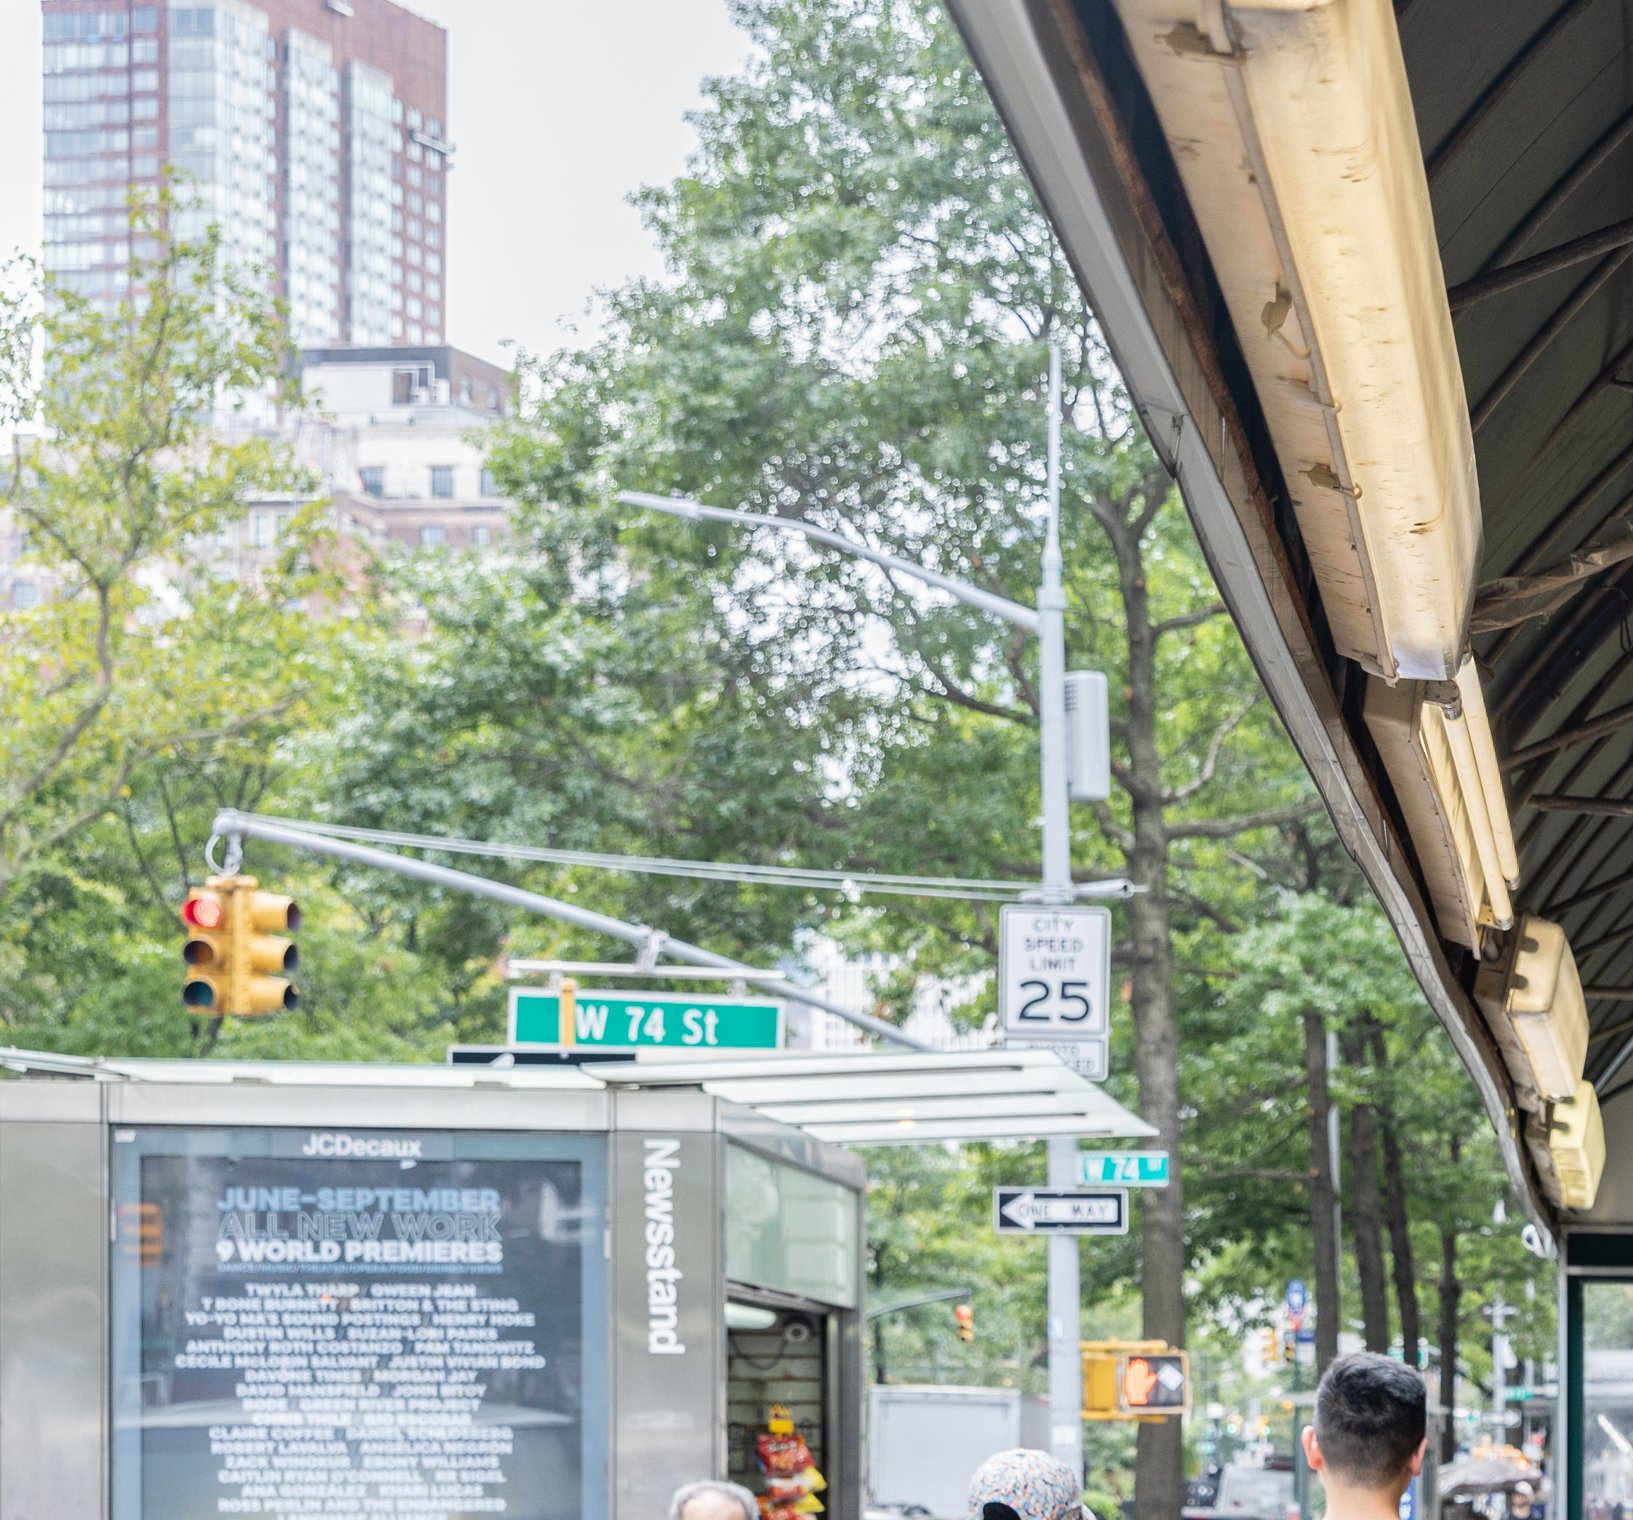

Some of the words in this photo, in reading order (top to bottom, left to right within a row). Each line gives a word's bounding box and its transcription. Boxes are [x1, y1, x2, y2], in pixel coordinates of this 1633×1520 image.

[1032, 917, 1075, 932] CITY
[1024, 937, 1084, 953] SPEED
[1029, 956, 1077, 972] LIMIT
[1019, 980, 1090, 1022] 25
[575, 1003, 609, 1041] W
[625, 1005, 666, 1043] 74
[682, 1008, 719, 1045] St
[303, 1133, 422, 1158] JCDecaux
[1083, 1157, 1105, 1181] W
[1111, 1157, 1140, 1181] 74
[1017, 1204, 1050, 1218] ONE
[1071, 1204, 1109, 1218] WAY
[217, 1211, 290, 1241] ALL
[297, 1212, 384, 1241] NEW
[391, 1212, 503, 1242] WORK
[215, 1239, 236, 1263] 9
[237, 1239, 342, 1263] WORLD
[344, 1239, 503, 1264] PREMIERES
[641, 1137, 687, 1356] Newsstand
[433, 1283, 476, 1297] JEAN
[435, 1297, 468, 1312] THE
